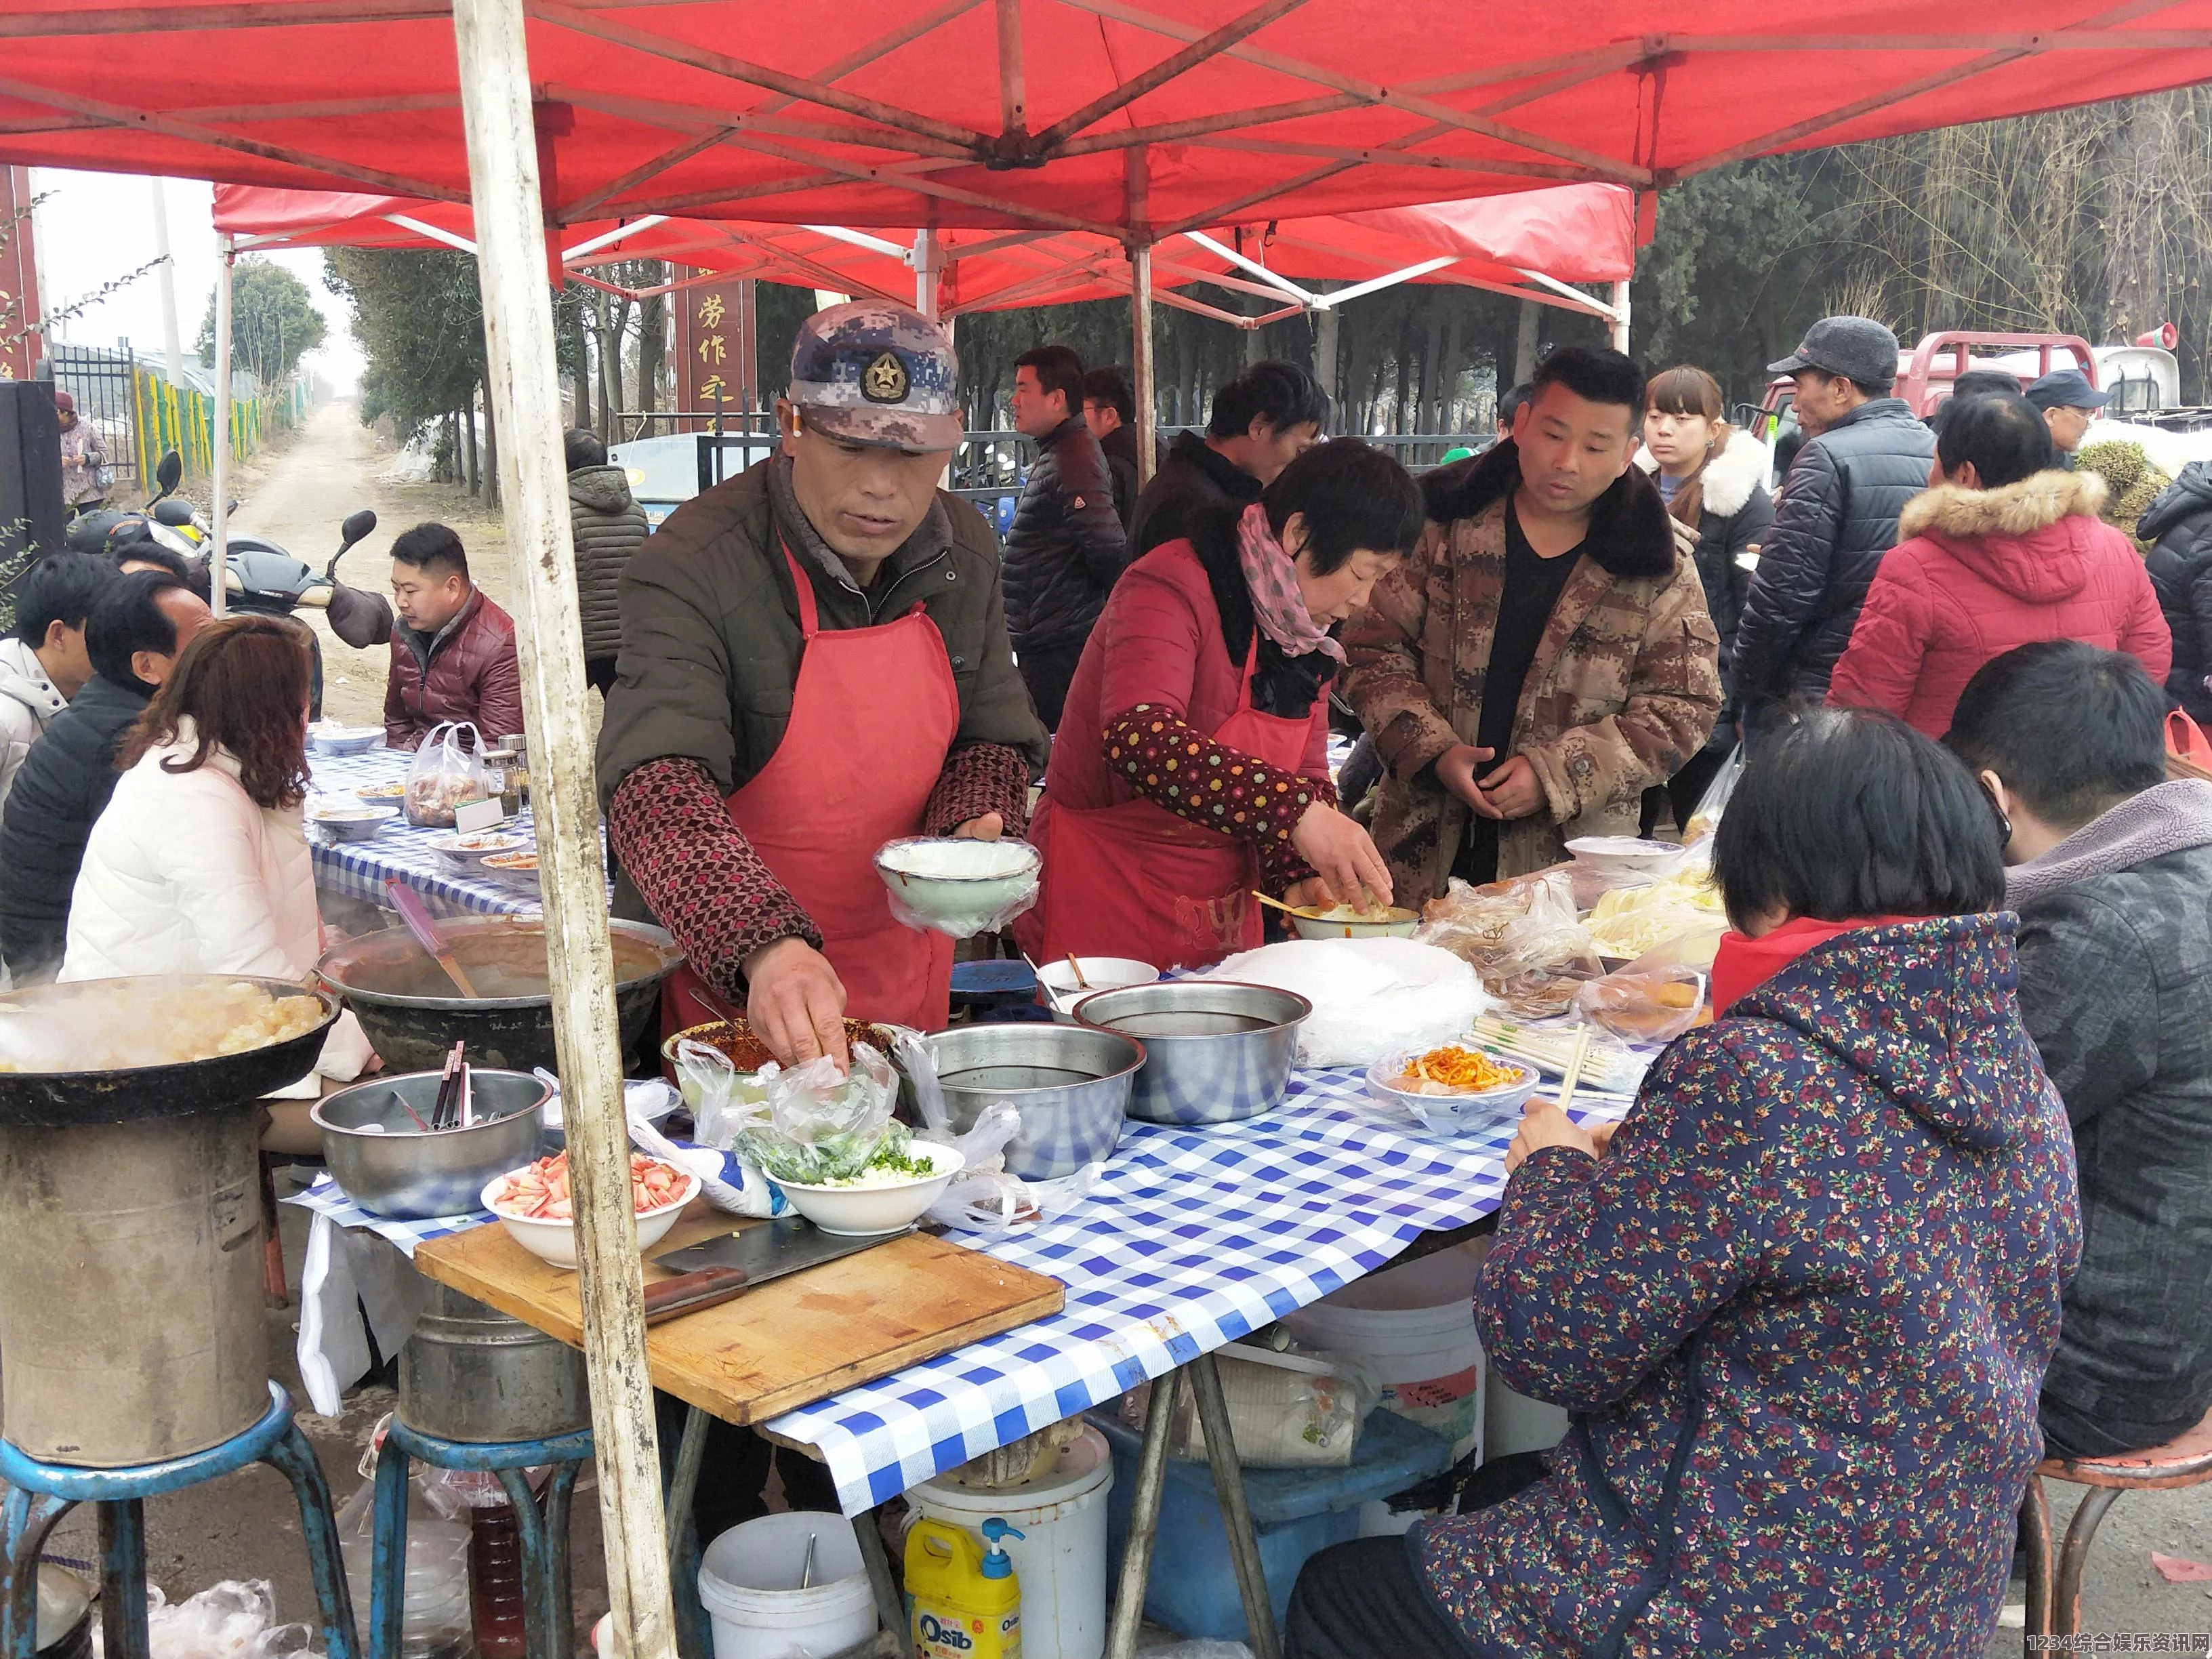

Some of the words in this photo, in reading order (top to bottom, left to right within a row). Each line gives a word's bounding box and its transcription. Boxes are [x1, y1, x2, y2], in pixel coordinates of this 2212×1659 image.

[698, 267, 735, 432] 劳作之
[920, 1615, 972, 1649] Osib
